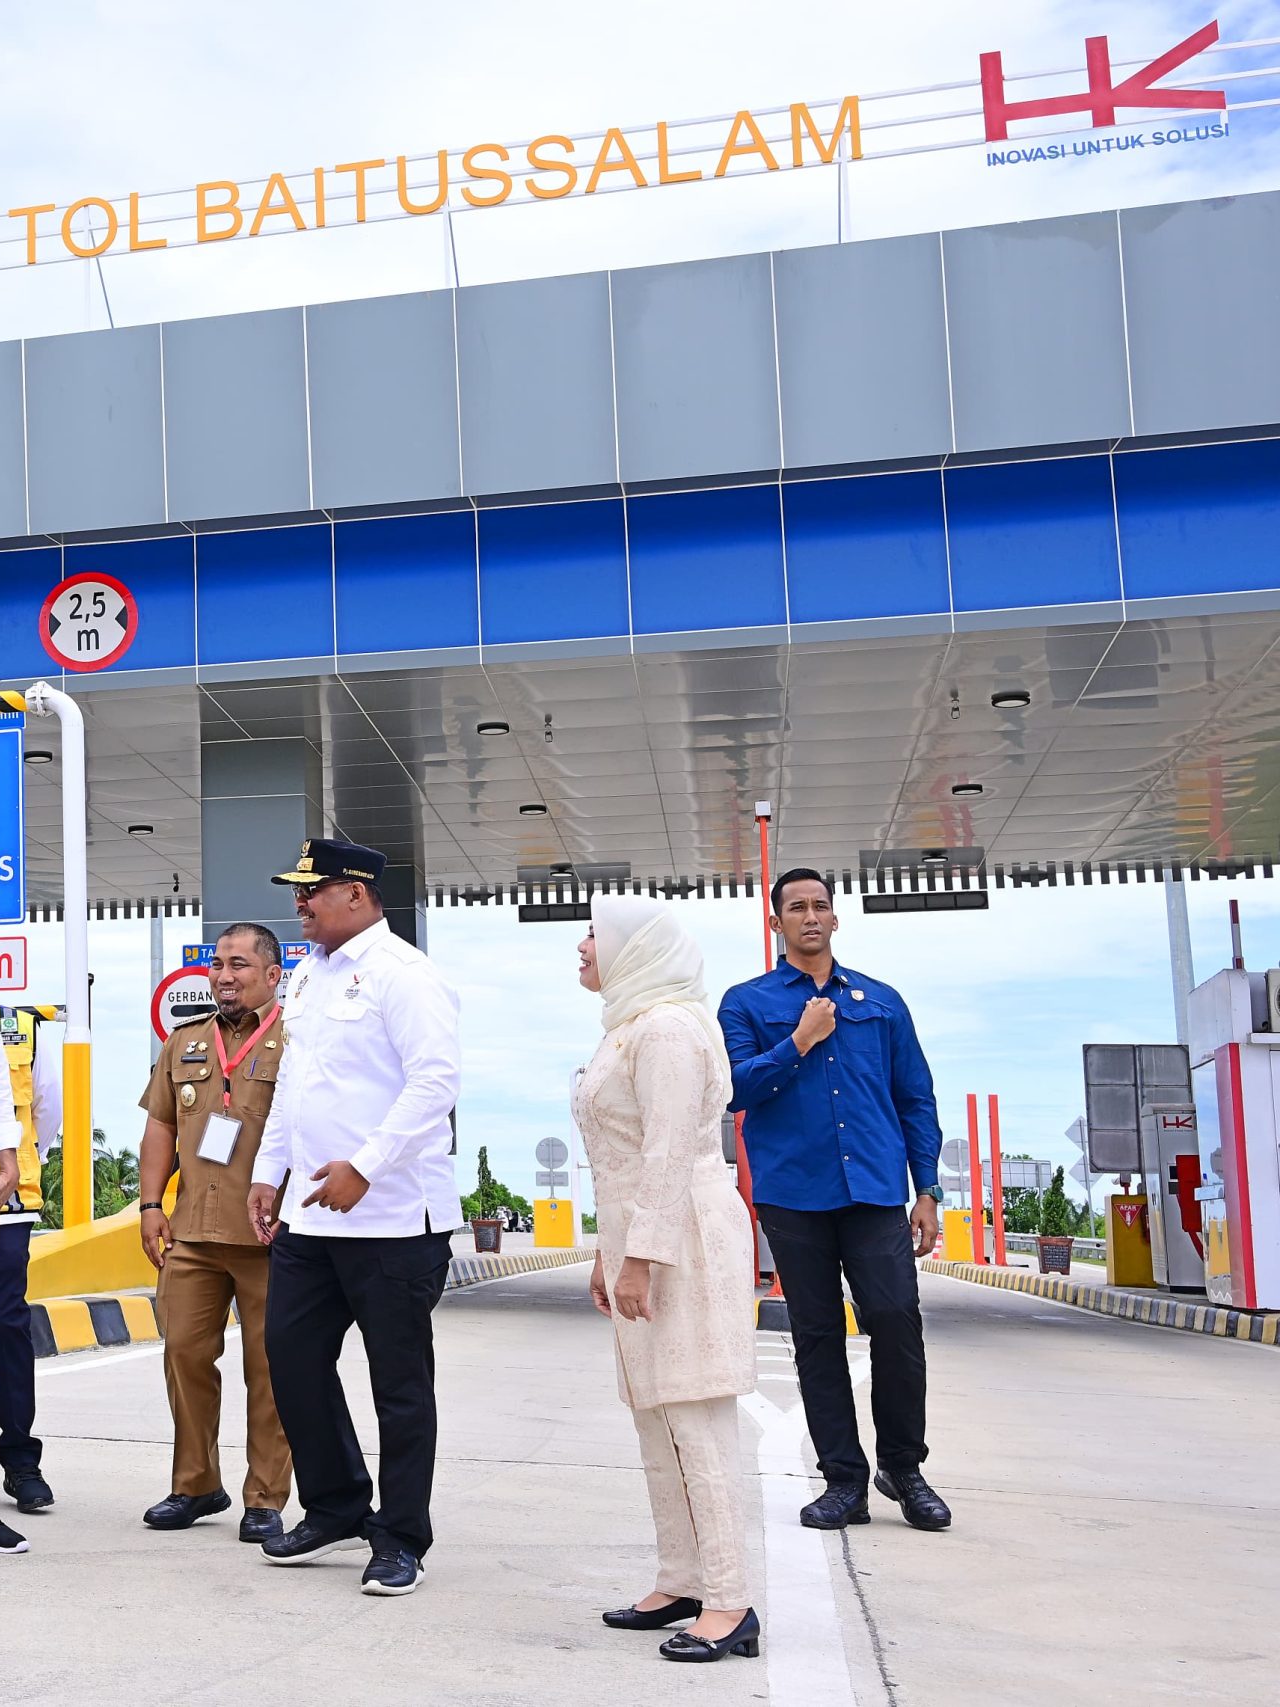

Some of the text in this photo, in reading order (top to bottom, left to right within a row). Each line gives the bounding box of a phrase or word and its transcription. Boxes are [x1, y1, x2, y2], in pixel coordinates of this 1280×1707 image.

[979, 19, 1227, 142] HK
[986, 122, 1230, 167] INOVASI UNTUK SOLUSI
[8, 192, 168, 266] TOL
[196, 95, 863, 243] BAITUSSALAM
[69, 591, 106, 623] 2,5
[77, 628, 100, 652] m
[168, 990, 214, 1003] GERBAN
[1163, 1115, 1194, 1128] HK
